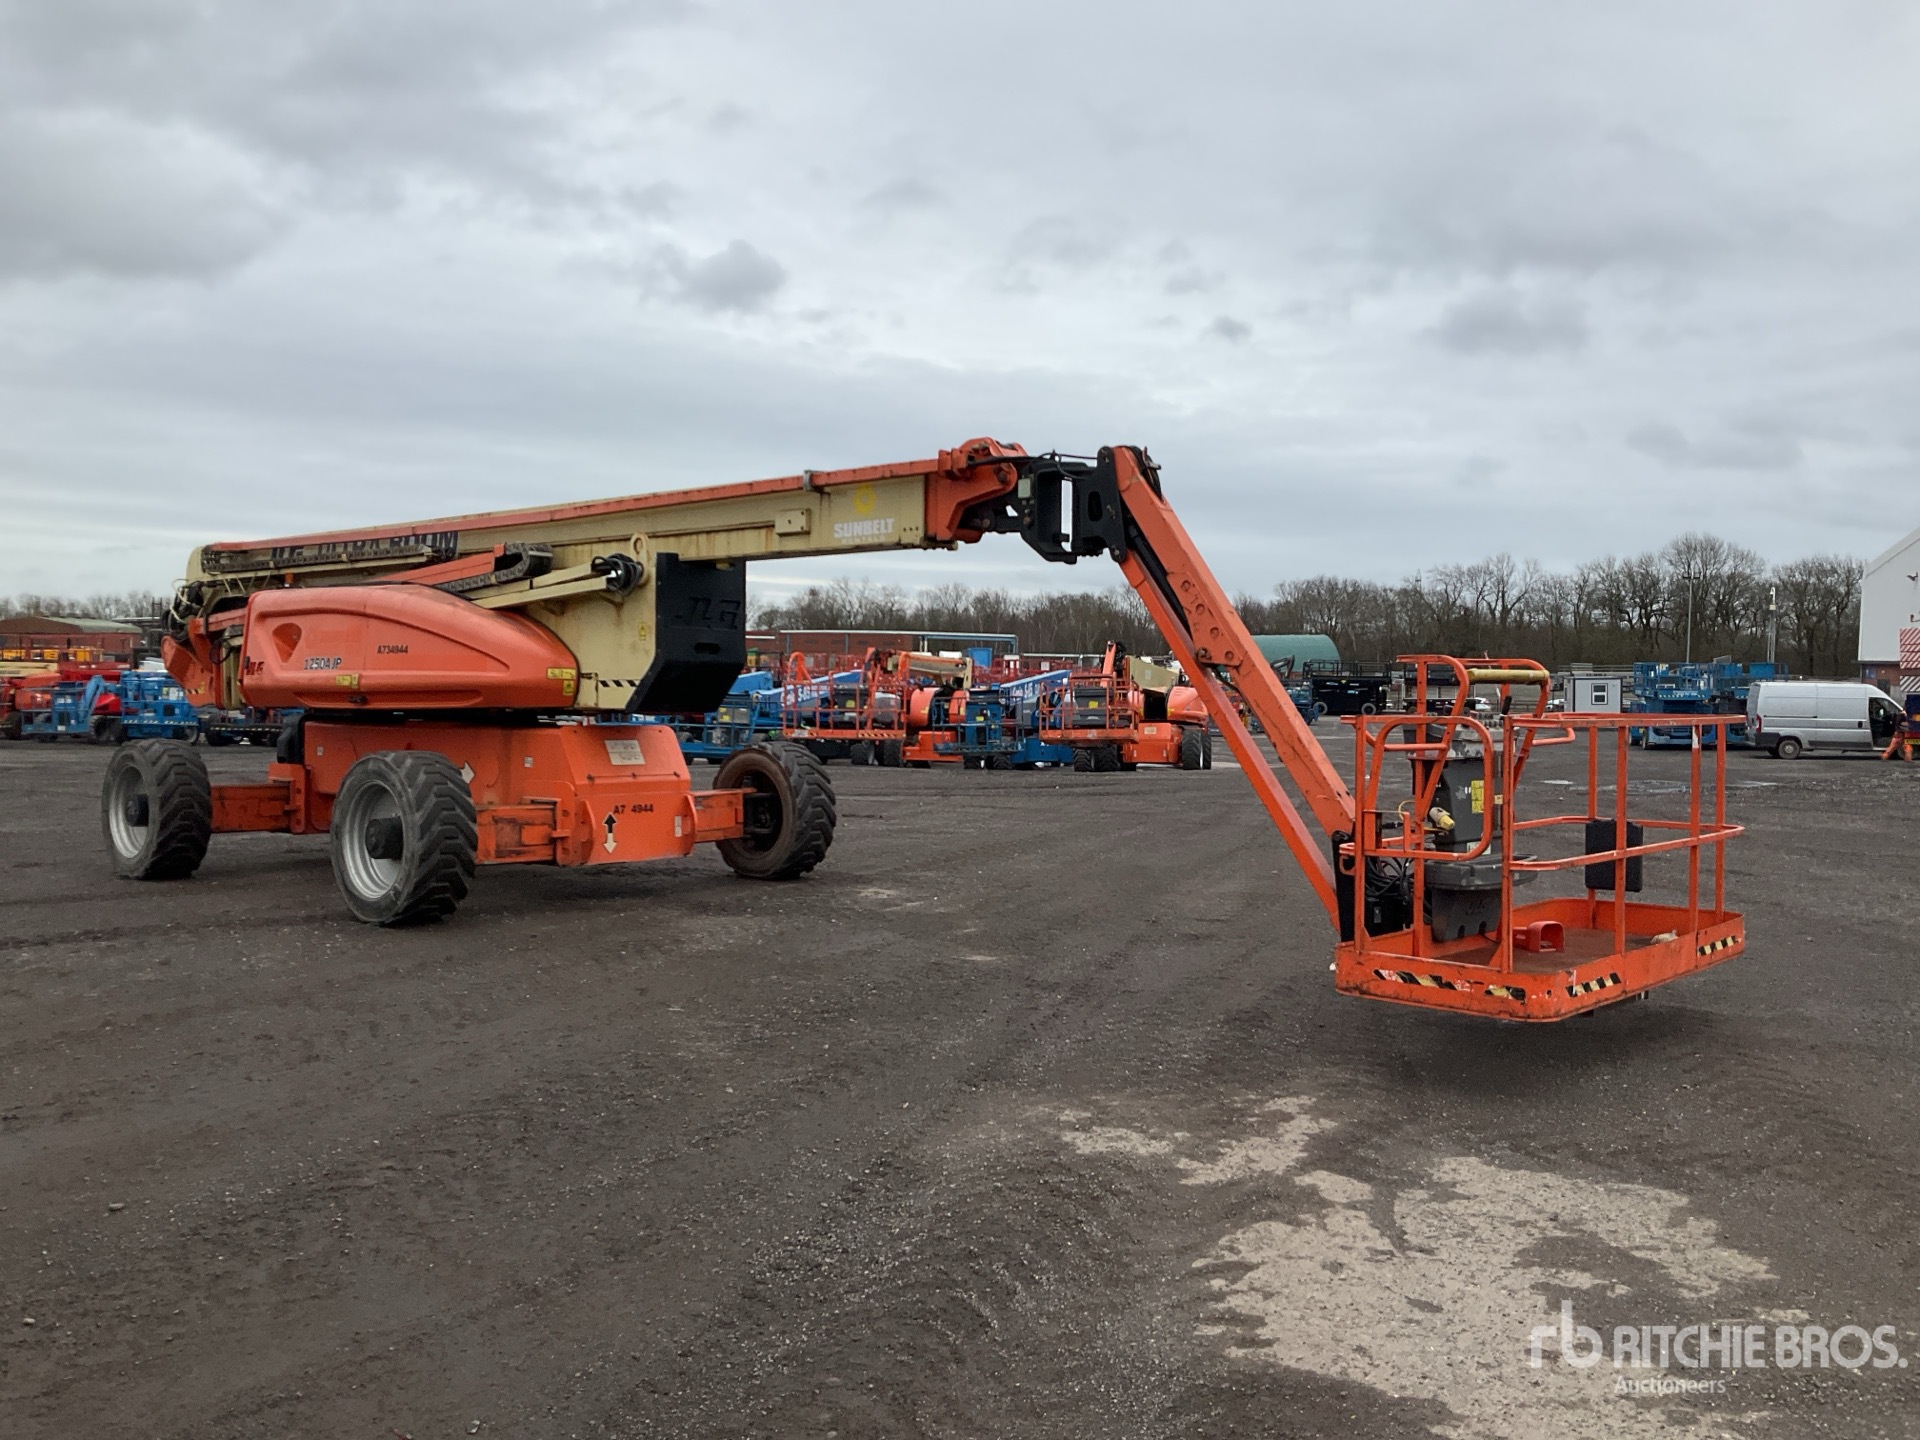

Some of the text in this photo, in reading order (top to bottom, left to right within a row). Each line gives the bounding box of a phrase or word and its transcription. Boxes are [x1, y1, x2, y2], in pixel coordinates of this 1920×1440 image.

[834, 518, 894, 538] SUNBELT
[304, 657, 342, 671] 1250AJP
[631, 803, 654, 814] 4944
